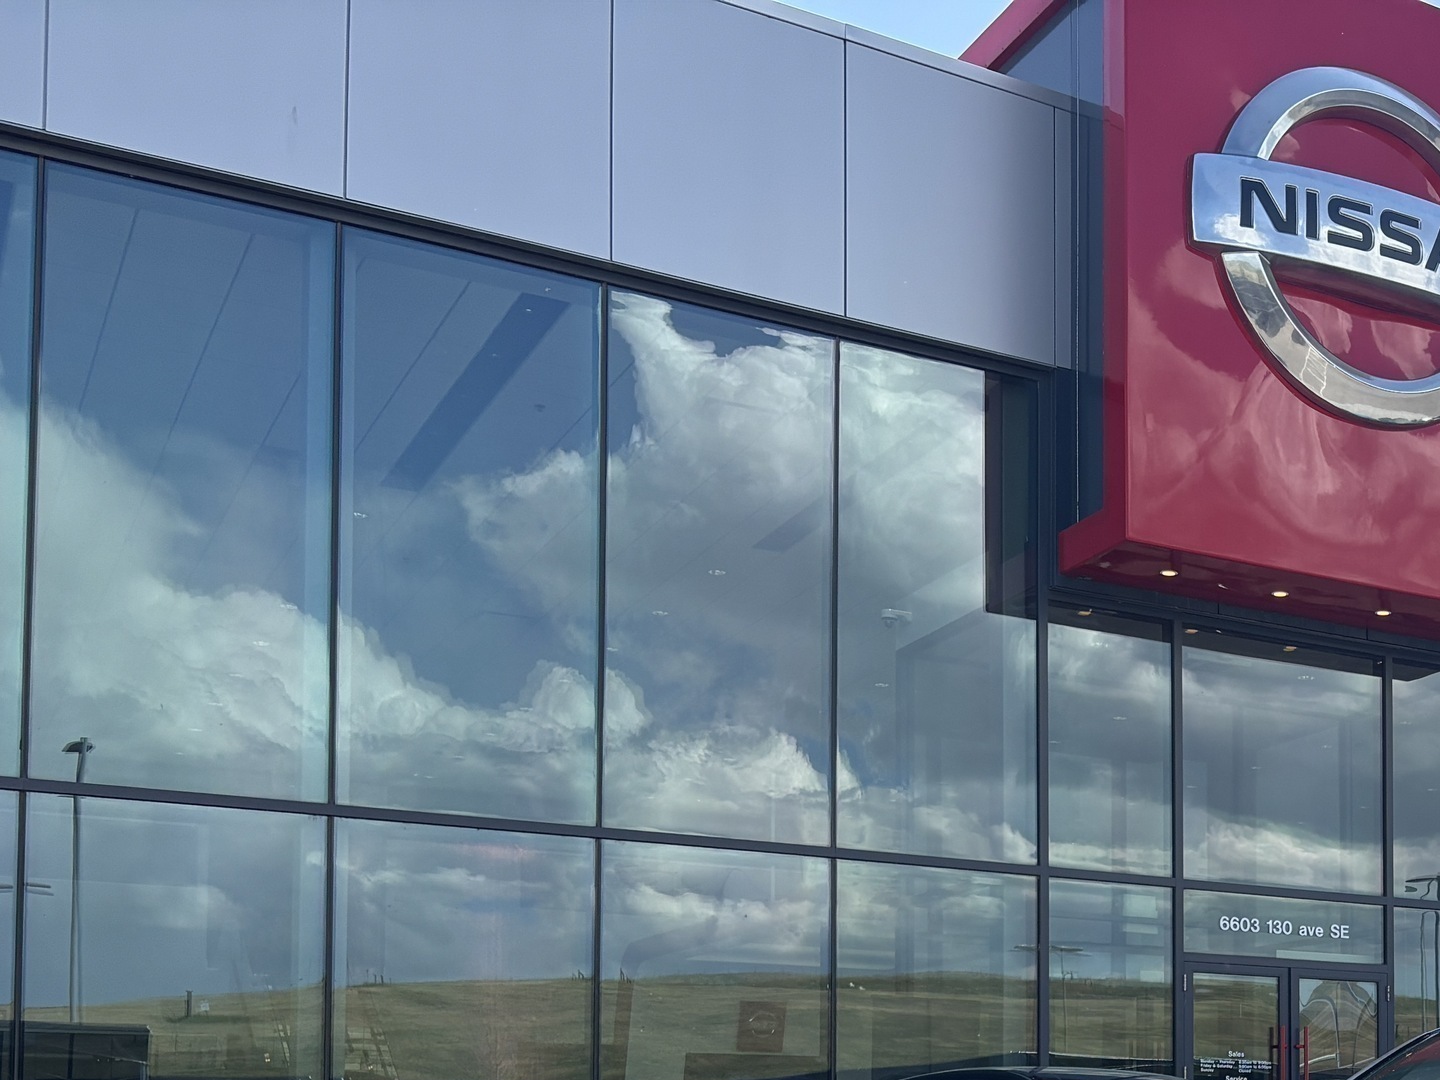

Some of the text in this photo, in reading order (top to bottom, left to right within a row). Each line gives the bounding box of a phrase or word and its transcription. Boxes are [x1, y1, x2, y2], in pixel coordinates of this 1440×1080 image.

[1219, 916, 1350, 939] 6603 130 ave SE
[1228, 1050, 1245, 1058] Sales
